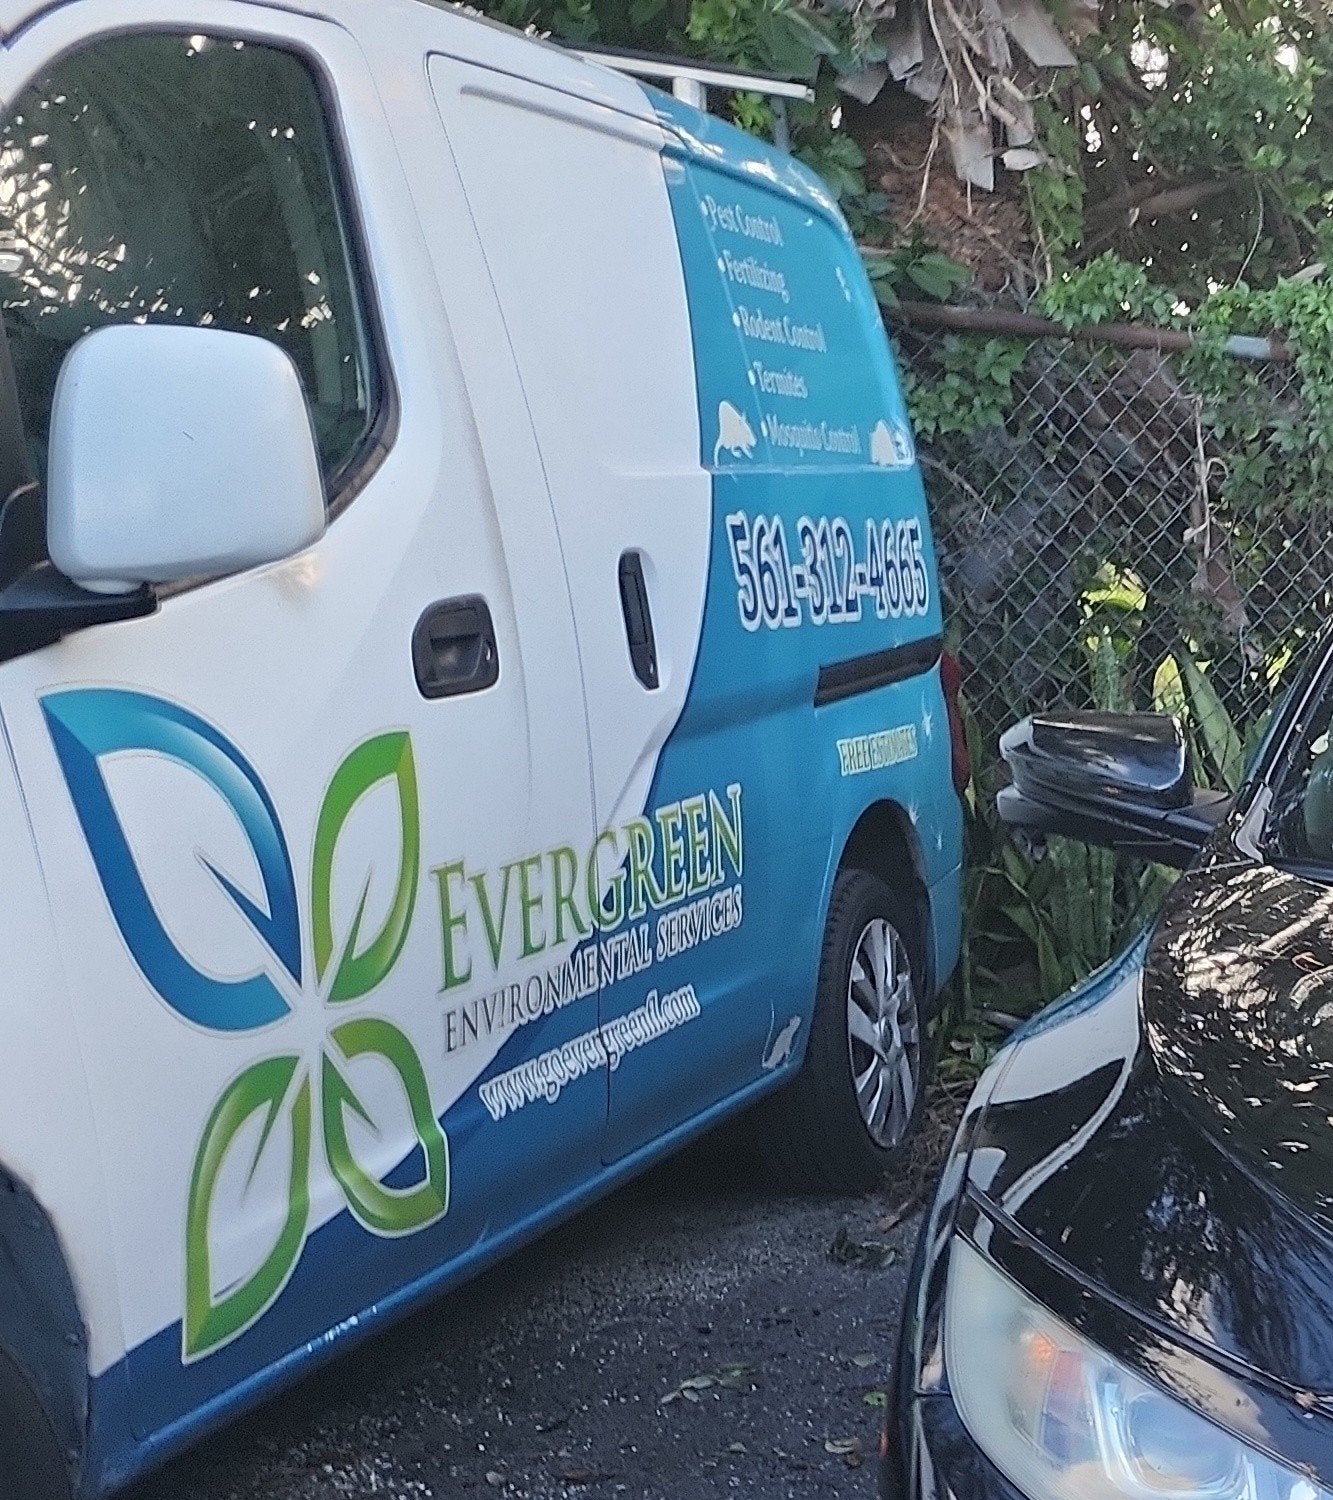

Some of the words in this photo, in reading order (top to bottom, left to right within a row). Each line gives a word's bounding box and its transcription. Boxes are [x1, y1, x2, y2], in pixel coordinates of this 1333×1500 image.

[704, 194, 740, 232] Pest
[725, 510, 929, 632] 561-312-4665
[836, 736, 872, 776] FREE
[430, 782, 743, 994] EVERGREEN
[444, 922, 653, 1054] ENVIRONMENTAL
[655, 883, 743, 963] SERVICES
[479, 984, 702, 1121] www.goevergreenfl.com
